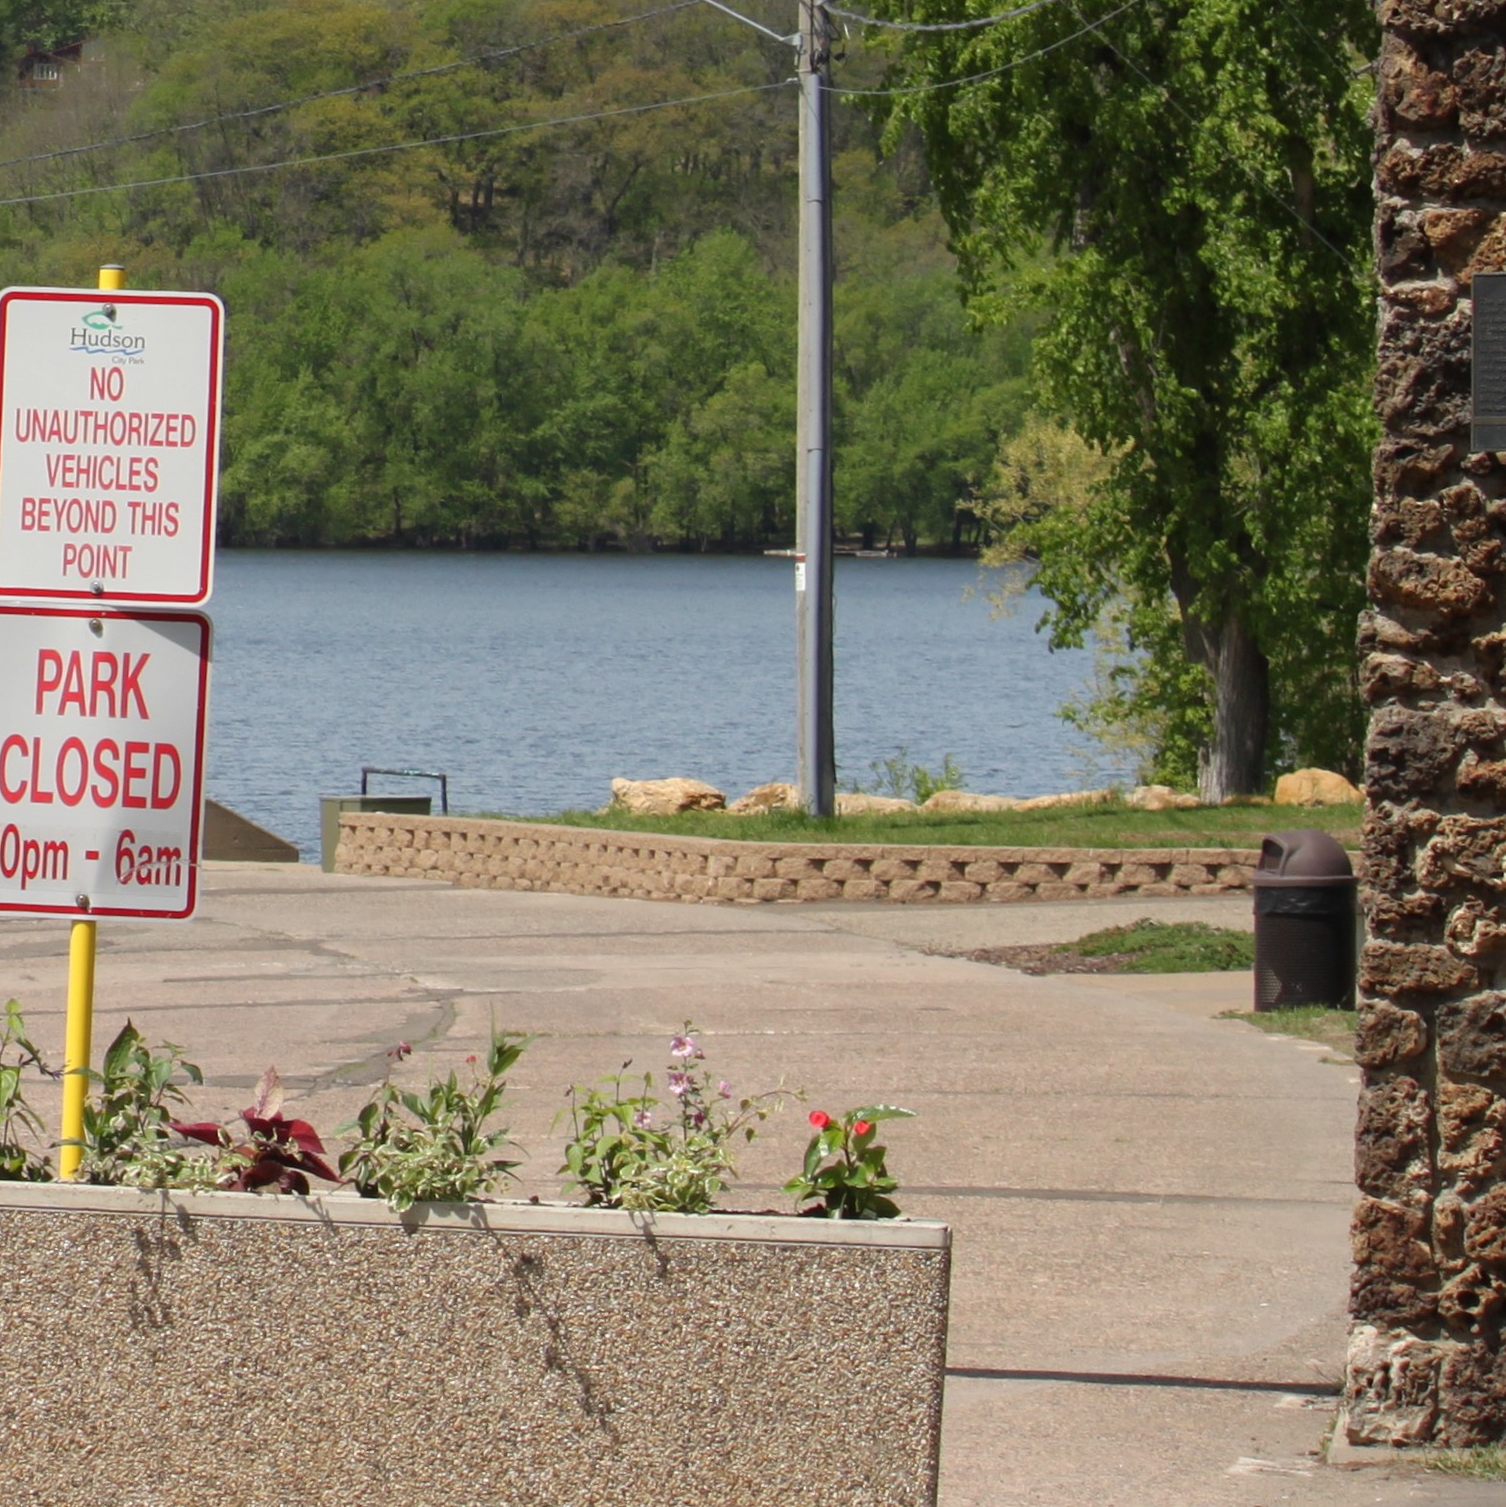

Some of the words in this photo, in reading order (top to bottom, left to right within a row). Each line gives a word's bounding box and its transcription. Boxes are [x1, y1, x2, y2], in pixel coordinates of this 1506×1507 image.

[70, 327, 146, 350] Hudson
[111, 355, 127, 365] City
[128, 356, 145, 365] Park
[90, 366, 124, 402] NO
[15, 408, 196, 448] UNAUTHORIZED
[46, 454, 159, 493] VEHICLES
[21, 497, 117, 534] BEYOND
[127, 501, 179, 537] THIS
[62, 543, 132, 579] POINT
[35, 649, 151, 720] PARK
[115, 829, 181, 887] 6am
